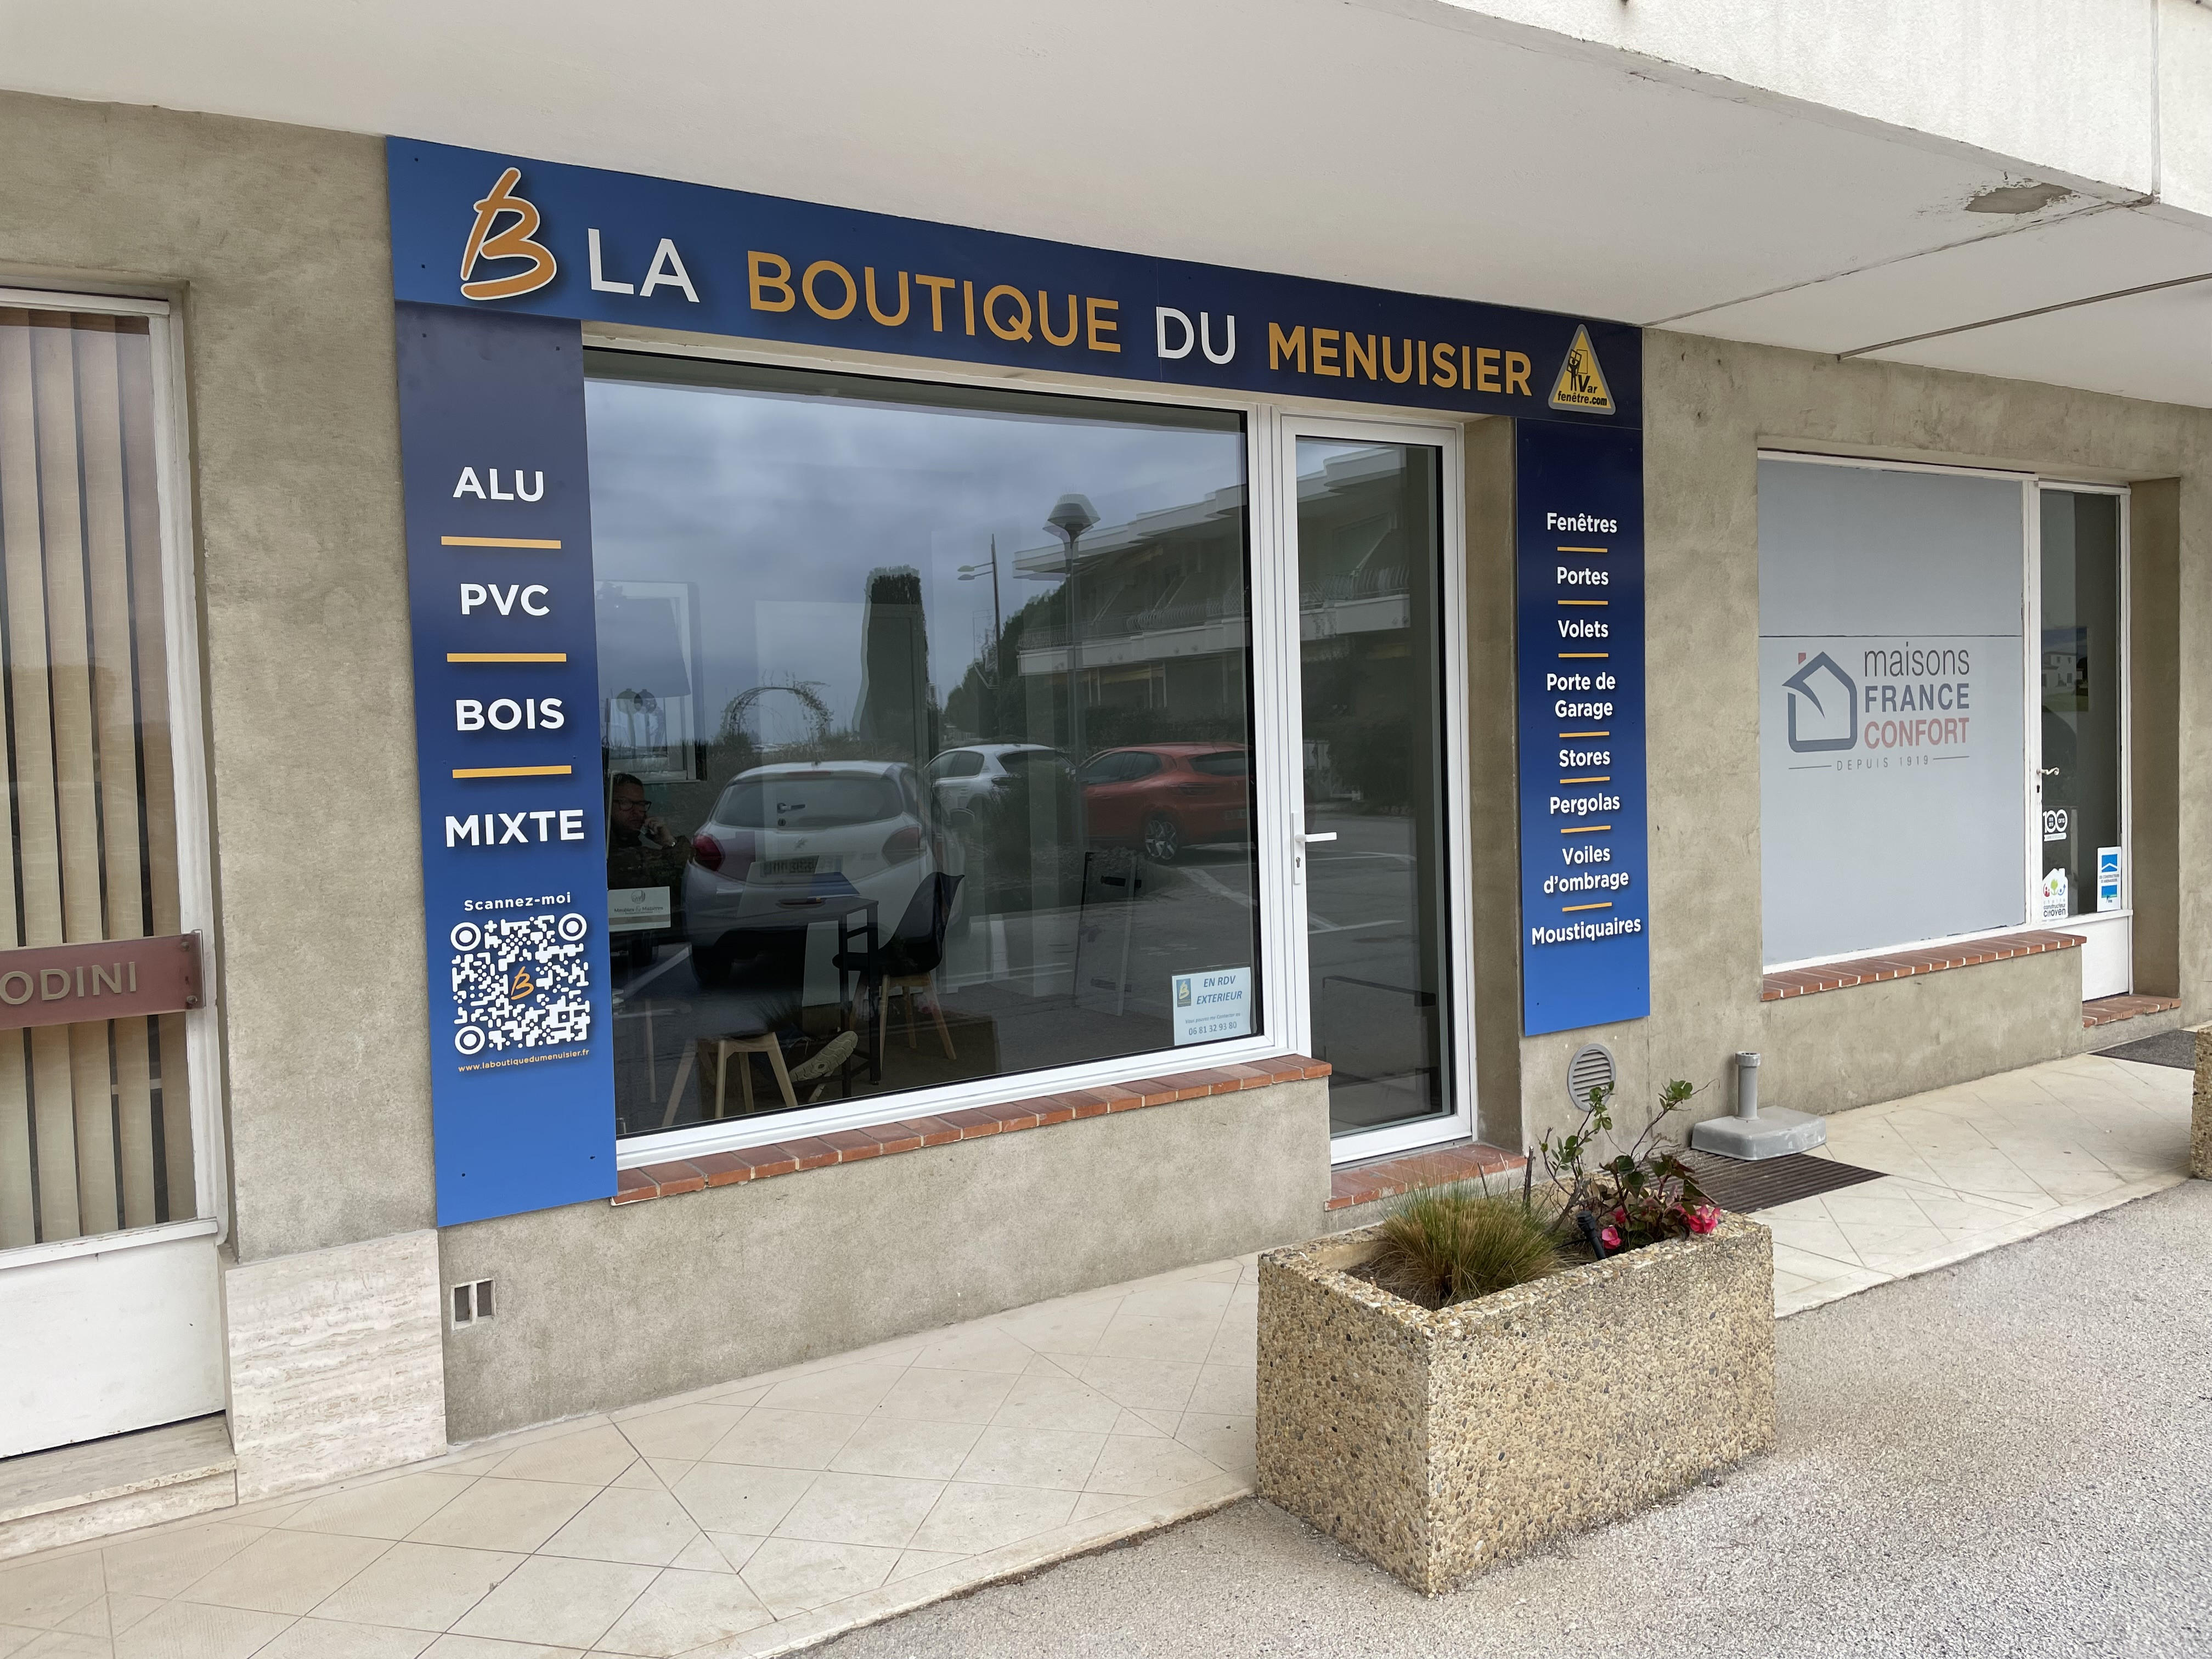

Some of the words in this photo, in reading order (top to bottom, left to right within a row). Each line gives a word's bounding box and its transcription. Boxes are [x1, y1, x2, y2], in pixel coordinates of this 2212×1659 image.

[460, 167, 557, 301] B
[588, 228, 699, 303] LA
[747, 250, 1121, 354] BOUTIQUE
[1156, 306, 1236, 365] DU
[1268, 321, 1532, 396] MENUISIER
[1578, 375, 1598, 393] Var
[1558, 390, 1607, 406] fenêtre.com
[453, 467, 544, 502] ALU
[1547, 512, 1618, 533] Fenêtres
[1557, 567, 1609, 585] Portes
[460, 583, 550, 616] PVC
[1558, 619, 1609, 637] Volets
[1865, 641, 1970, 676] maisons
[1547, 673, 1590, 691] Porte
[1595, 672, 1616, 690] de
[1865, 683, 1970, 713] FRANCE
[456, 698, 565, 731] BOIS
[1555, 700, 1613, 720] Garage
[1864, 718, 1970, 749] CONFORT
[1559, 749, 1611, 767] Stores
[1837, 758, 1888, 771] DEPUIS
[1899, 755, 1929, 766] 1919
[1550, 793, 1620, 816] Pergolas
[445, 809, 584, 848] MIXTE
[2042, 809, 2068, 833] 100
[1562, 845, 1611, 865] Voiles
[464, 891, 571, 911] Scannez-moi
[2044, 908, 2066, 917] citoyen
[1532, 917, 1641, 945] Moustiquaires
[0, 961, 137, 1005] ODINI
[511, 966, 534, 1000] B
[1204, 978, 1215, 988] EN
[1217, 975, 1236, 986] RDV
[1197, 990, 1243, 1005] EXTERIEUR
[1188, 1027, 1197, 1035] 06
[1219, 1023, 1227, 1031] 93
[1229, 1021, 1237, 1029] 80
[458, 1048, 590, 1073] www.laboutiquedumenuisier.fr
